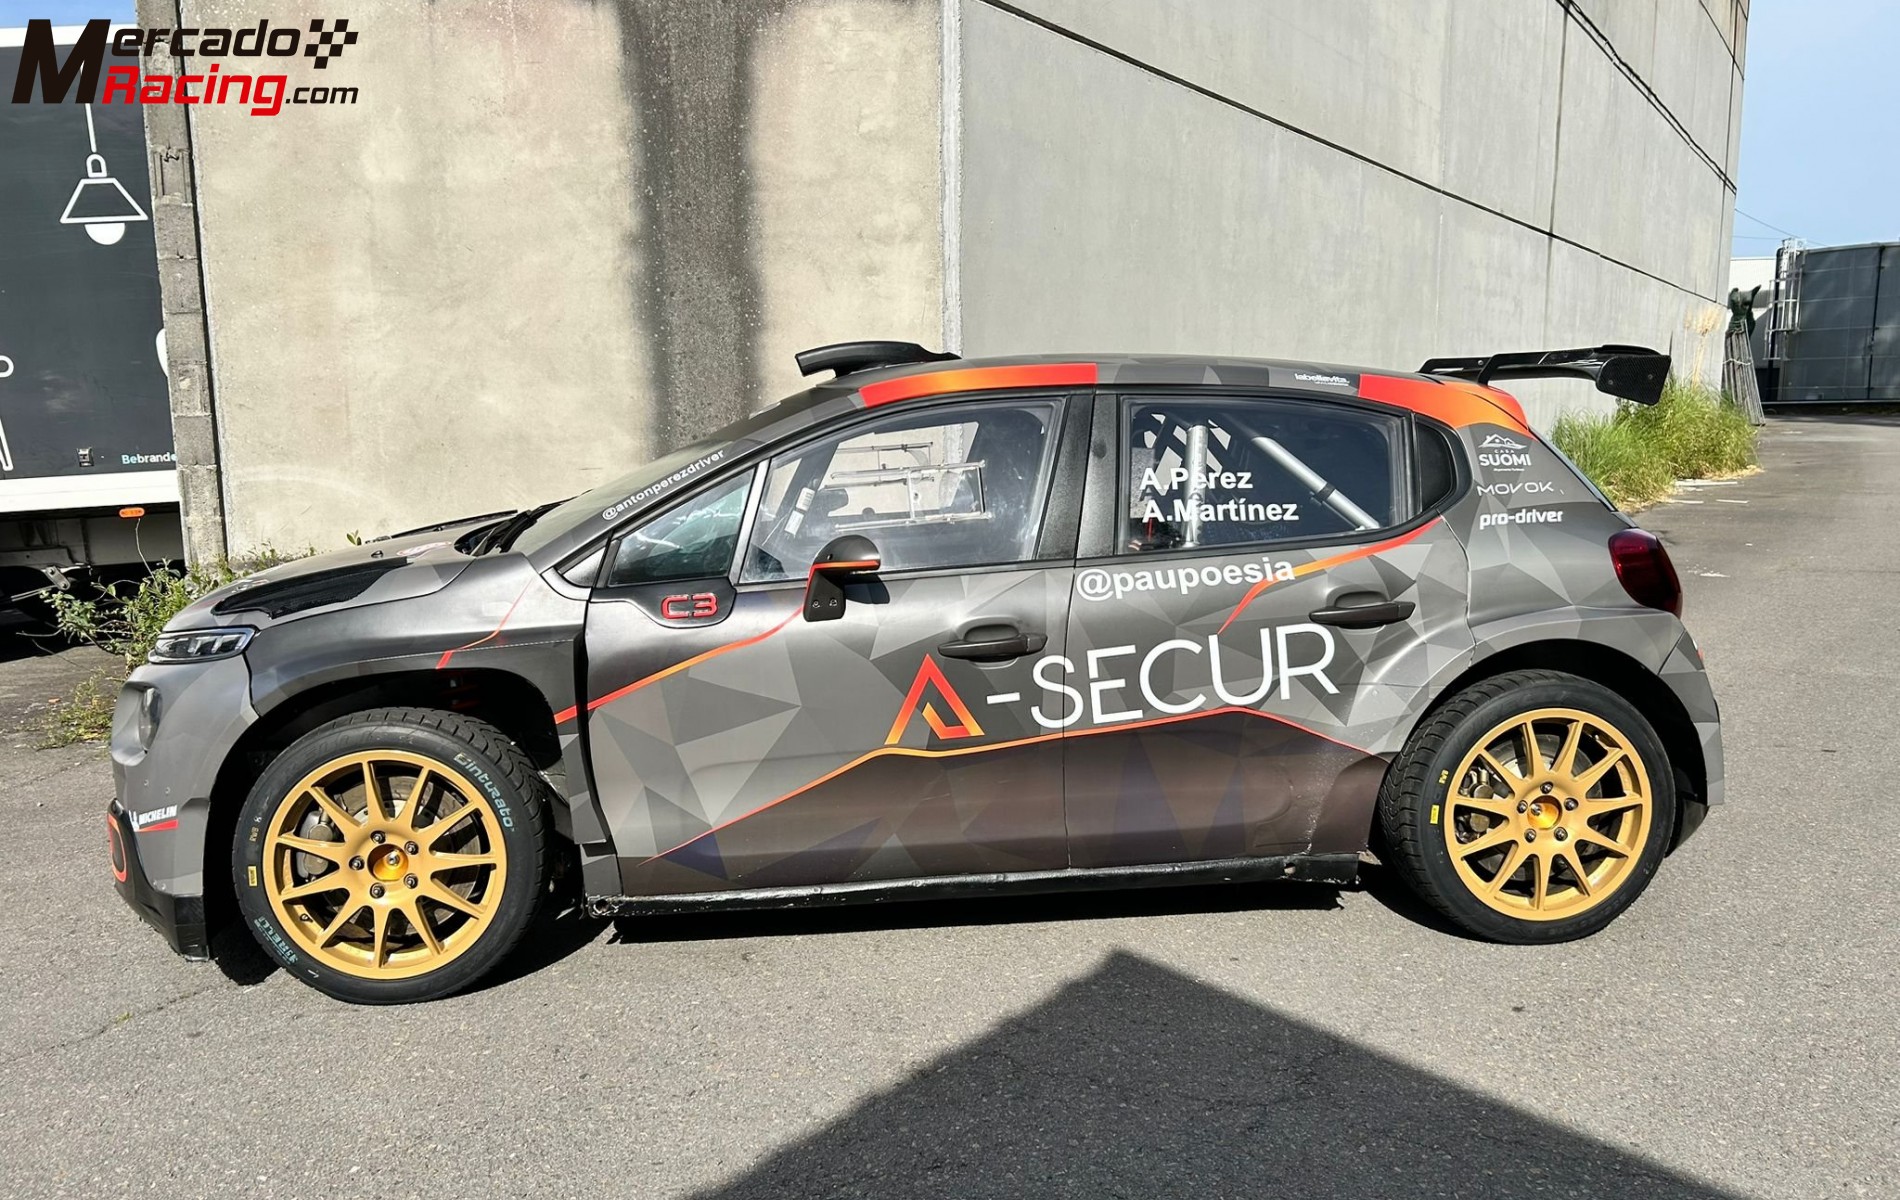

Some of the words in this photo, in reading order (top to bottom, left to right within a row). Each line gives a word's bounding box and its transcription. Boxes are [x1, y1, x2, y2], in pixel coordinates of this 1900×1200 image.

[1478, 453, 1532, 466] SUOMI
[602, 449, 724, 520] @antonperezdriver
[1139, 467, 1254, 491] A.Perez
[1476, 481, 1554, 496] MOVOK
[1479, 508, 1564, 530] pro-driver
[1076, 556, 1295, 602] @paupoesia
[661, 592, 718, 620] C3
[138, 804, 178, 826] MICHELIN
